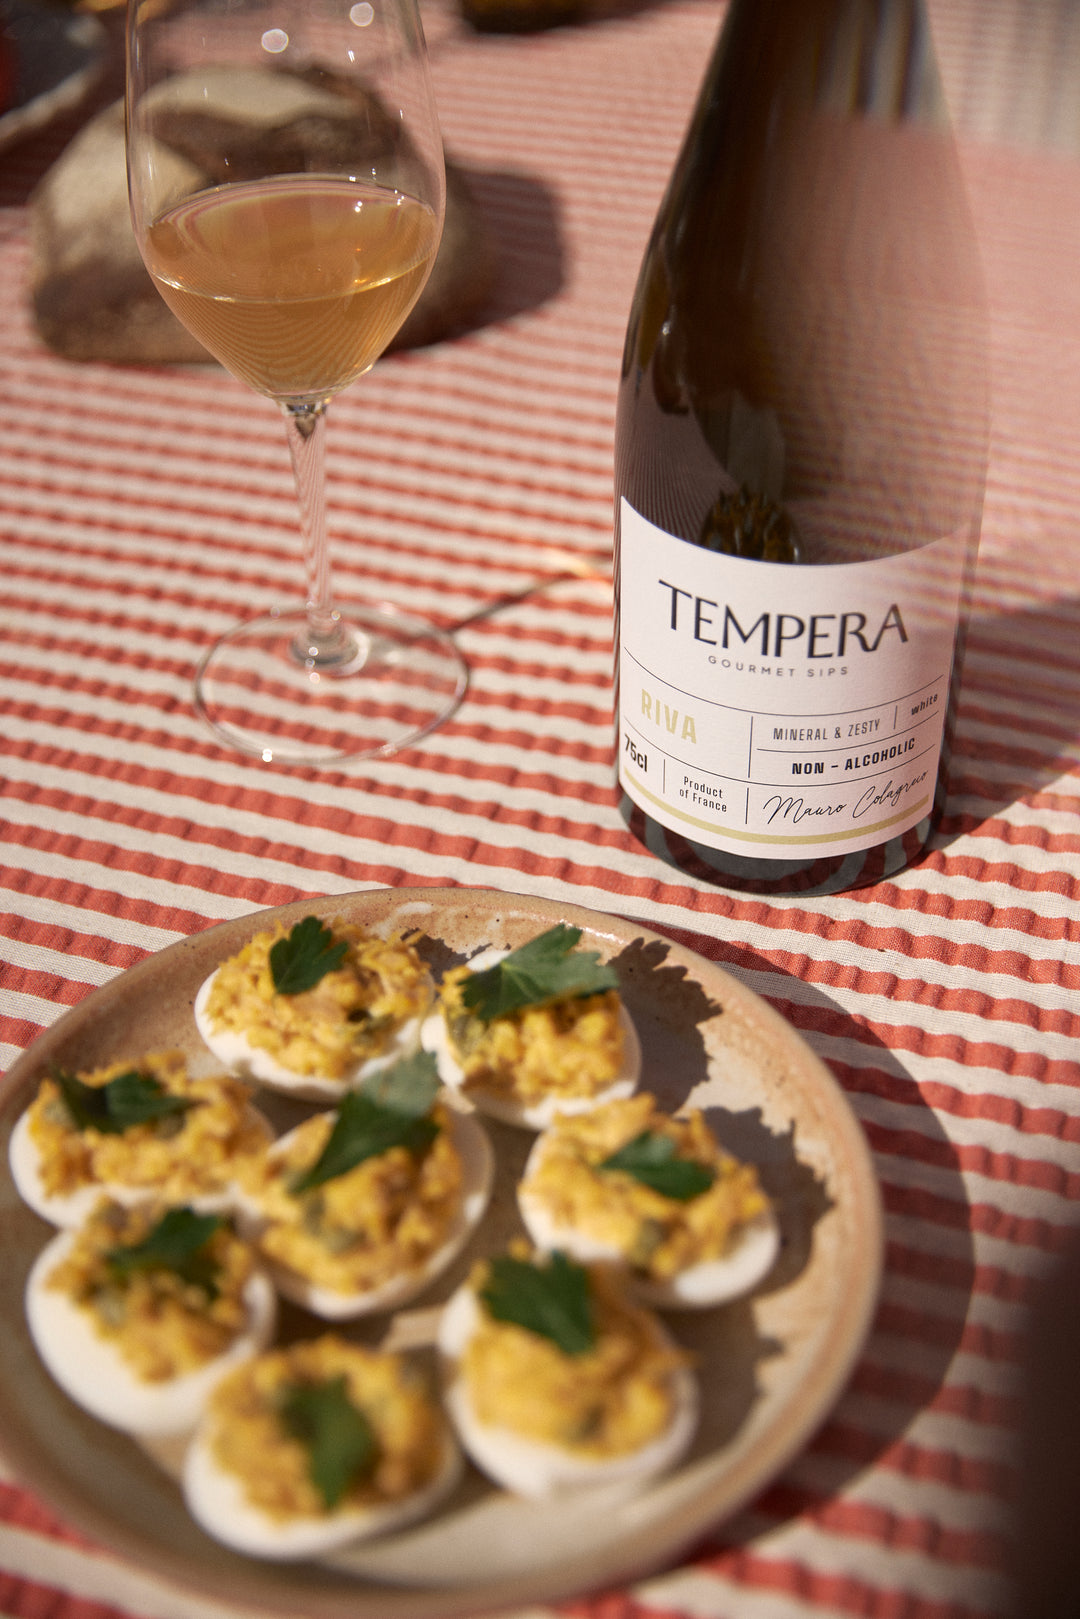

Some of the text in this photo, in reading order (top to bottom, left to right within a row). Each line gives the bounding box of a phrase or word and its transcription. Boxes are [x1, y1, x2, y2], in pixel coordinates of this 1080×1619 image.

[658, 579, 909, 658] TEMPERA
[708, 655, 848, 677] GOURMET SIPS
[641, 688, 697, 744] RIVA
[911, 693, 938, 715] white
[773, 718, 881, 741] MINERAL & ZESTY
[624, 733, 648, 772] 75cl
[792, 762, 824, 774] NON
[845, 738, 915, 770] ALCOHOLIC
[679, 789, 727, 812] of France
[683, 776, 723, 799] Product
[763, 795, 847, 824] Mauro
